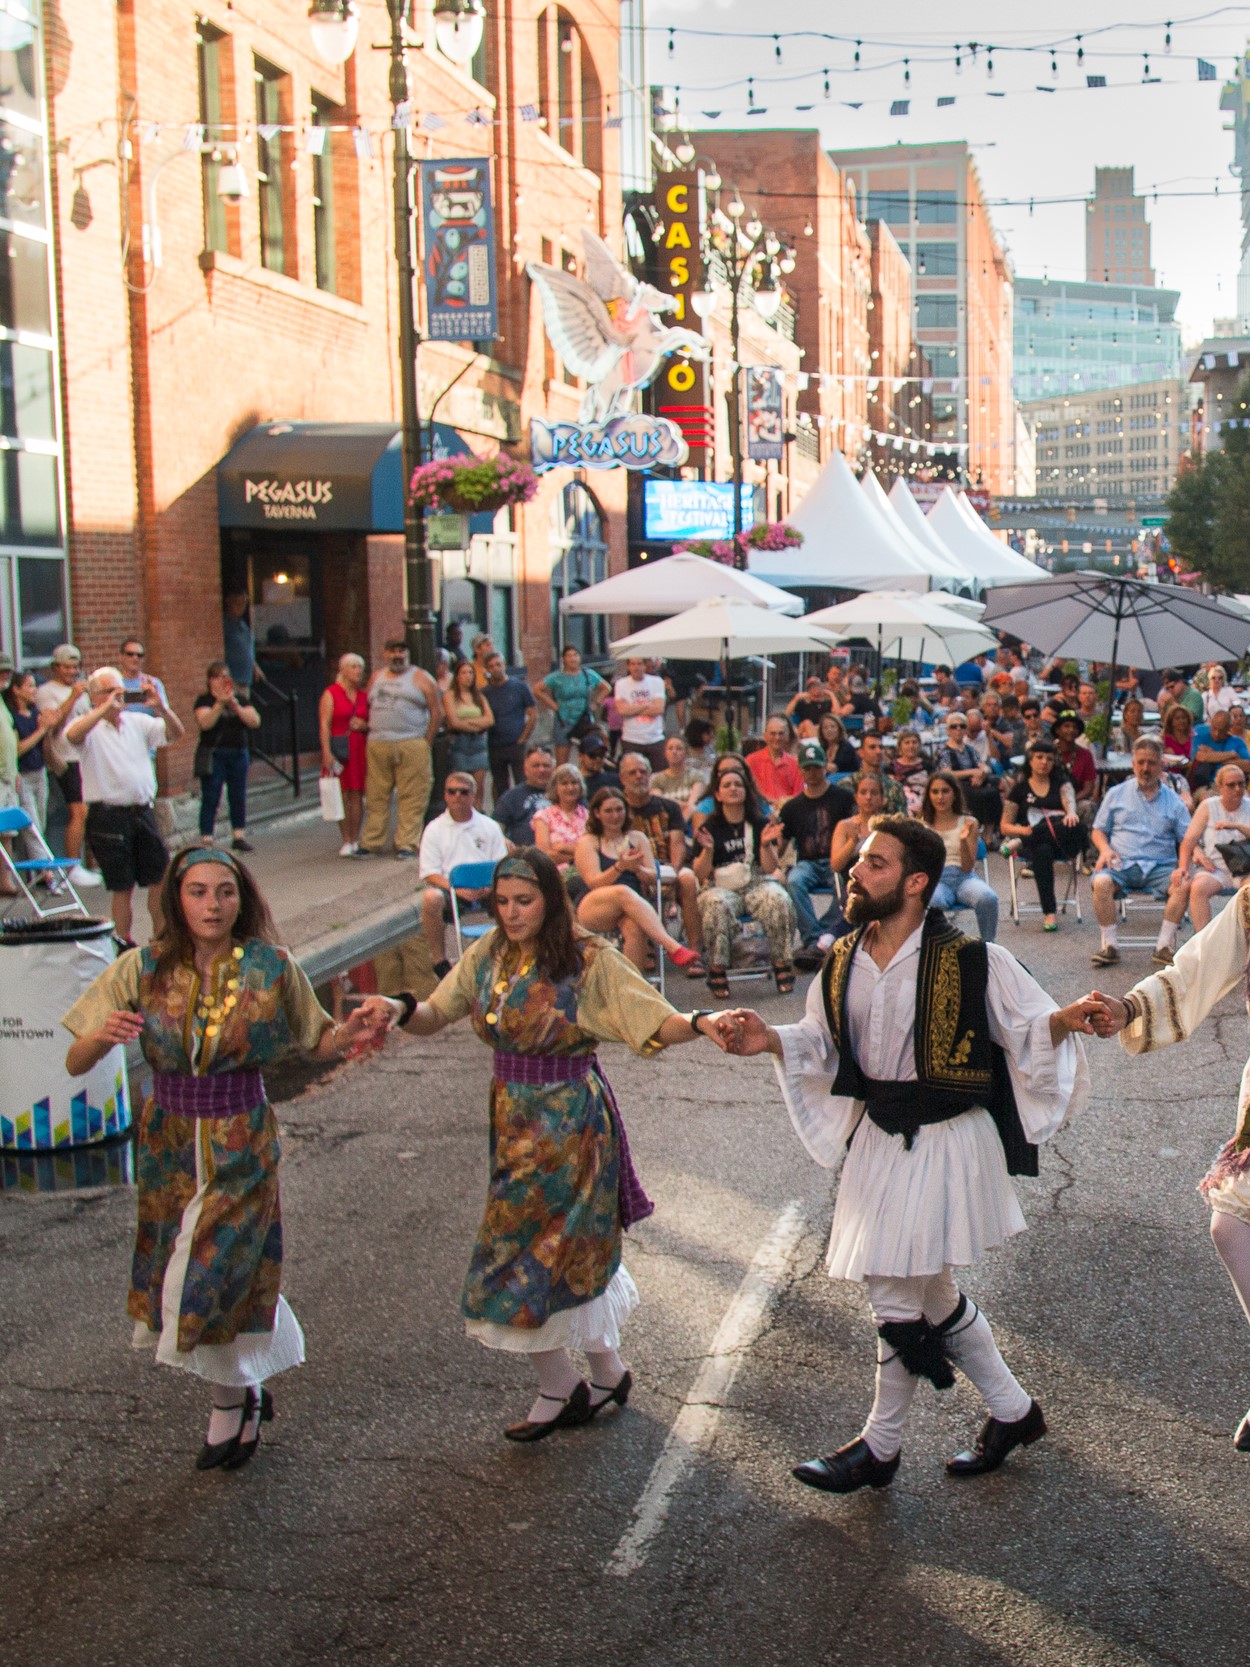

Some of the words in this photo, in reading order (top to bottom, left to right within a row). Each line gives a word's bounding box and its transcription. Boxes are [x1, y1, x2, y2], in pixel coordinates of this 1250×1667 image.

[552, 431, 663, 458] PEGASUS
[245, 479, 333, 504] PEGASUS
[263, 504, 317, 520] TAVERNA
[666, 509, 729, 528] FESTIVAL
[3, 1016, 23, 1027] FOR
